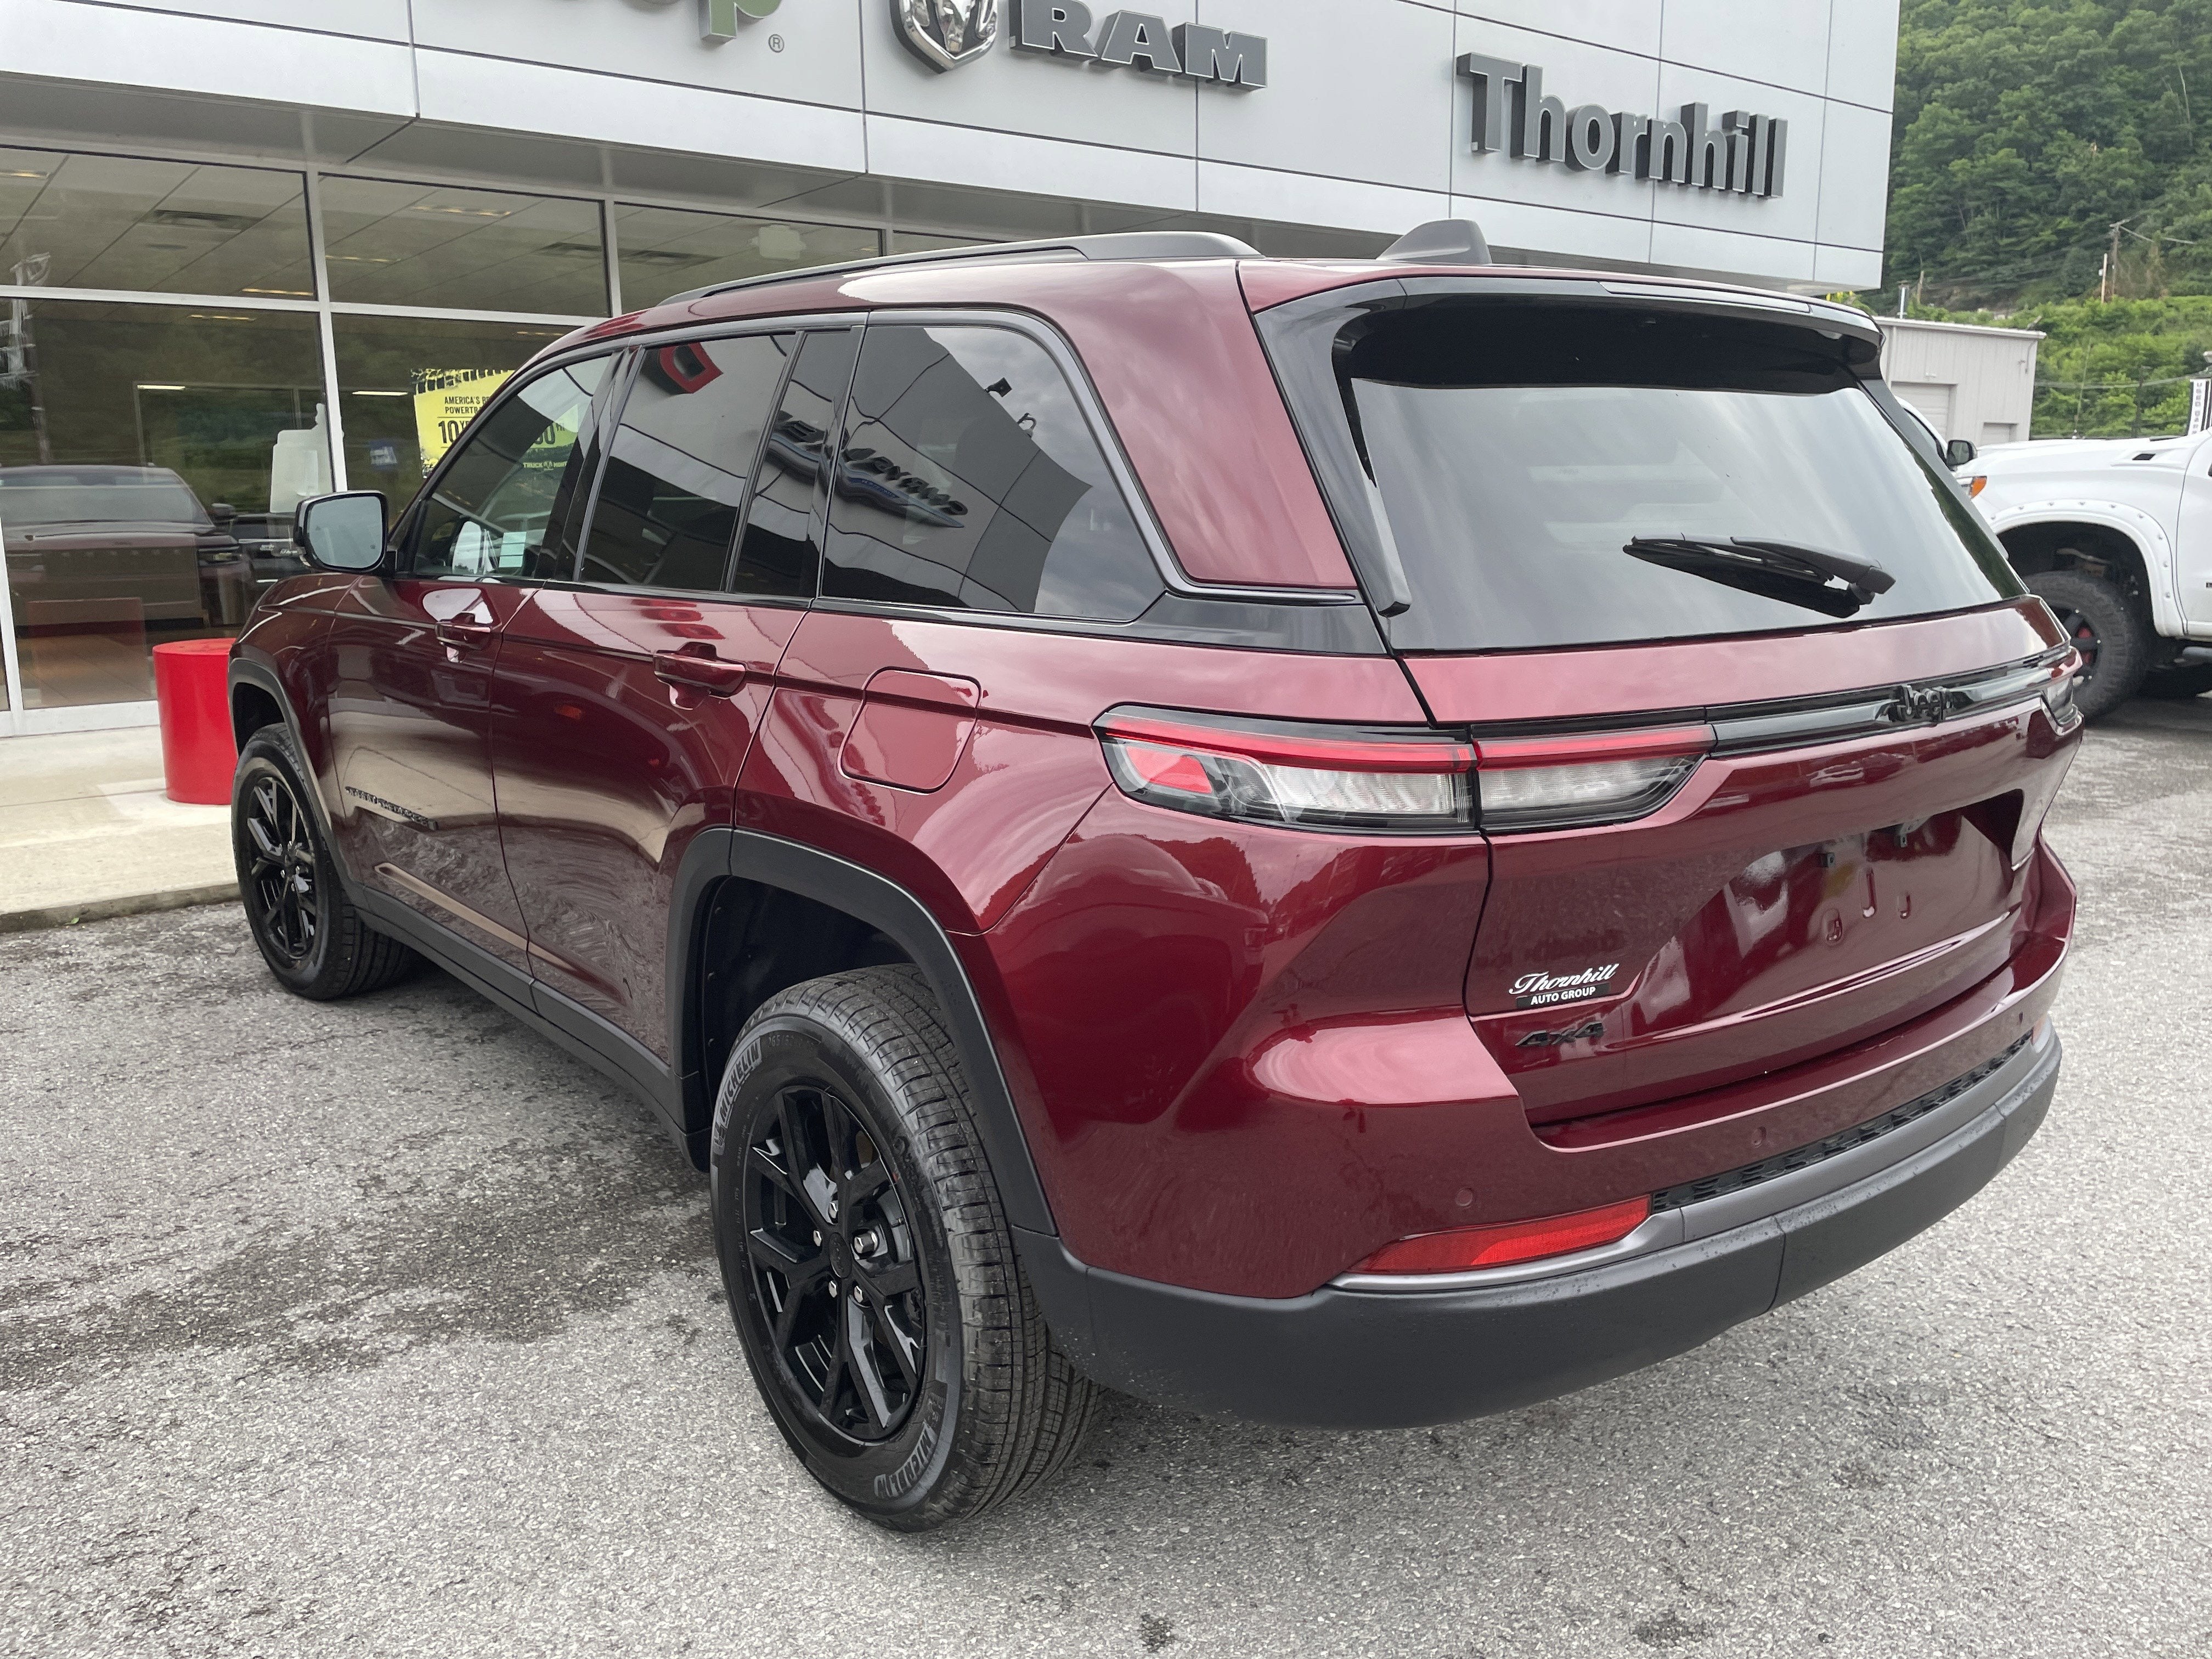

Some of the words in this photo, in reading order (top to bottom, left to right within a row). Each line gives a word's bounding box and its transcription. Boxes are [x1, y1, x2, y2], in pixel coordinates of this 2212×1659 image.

[1009, 0, 1268, 91] RAM
[1457, 53, 1788, 198] Thornhill
[444, 396, 481, 404] AMERICA'S
[445, 406, 480, 414] POWERTR
[438, 420, 459, 444] 10
[1509, 963, 1620, 995] Thornhill
[1530, 992, 1559, 1006] AUTO
[1560, 986, 1596, 1001] GROUP
[719, 1039, 761, 1124] MICHELIN
